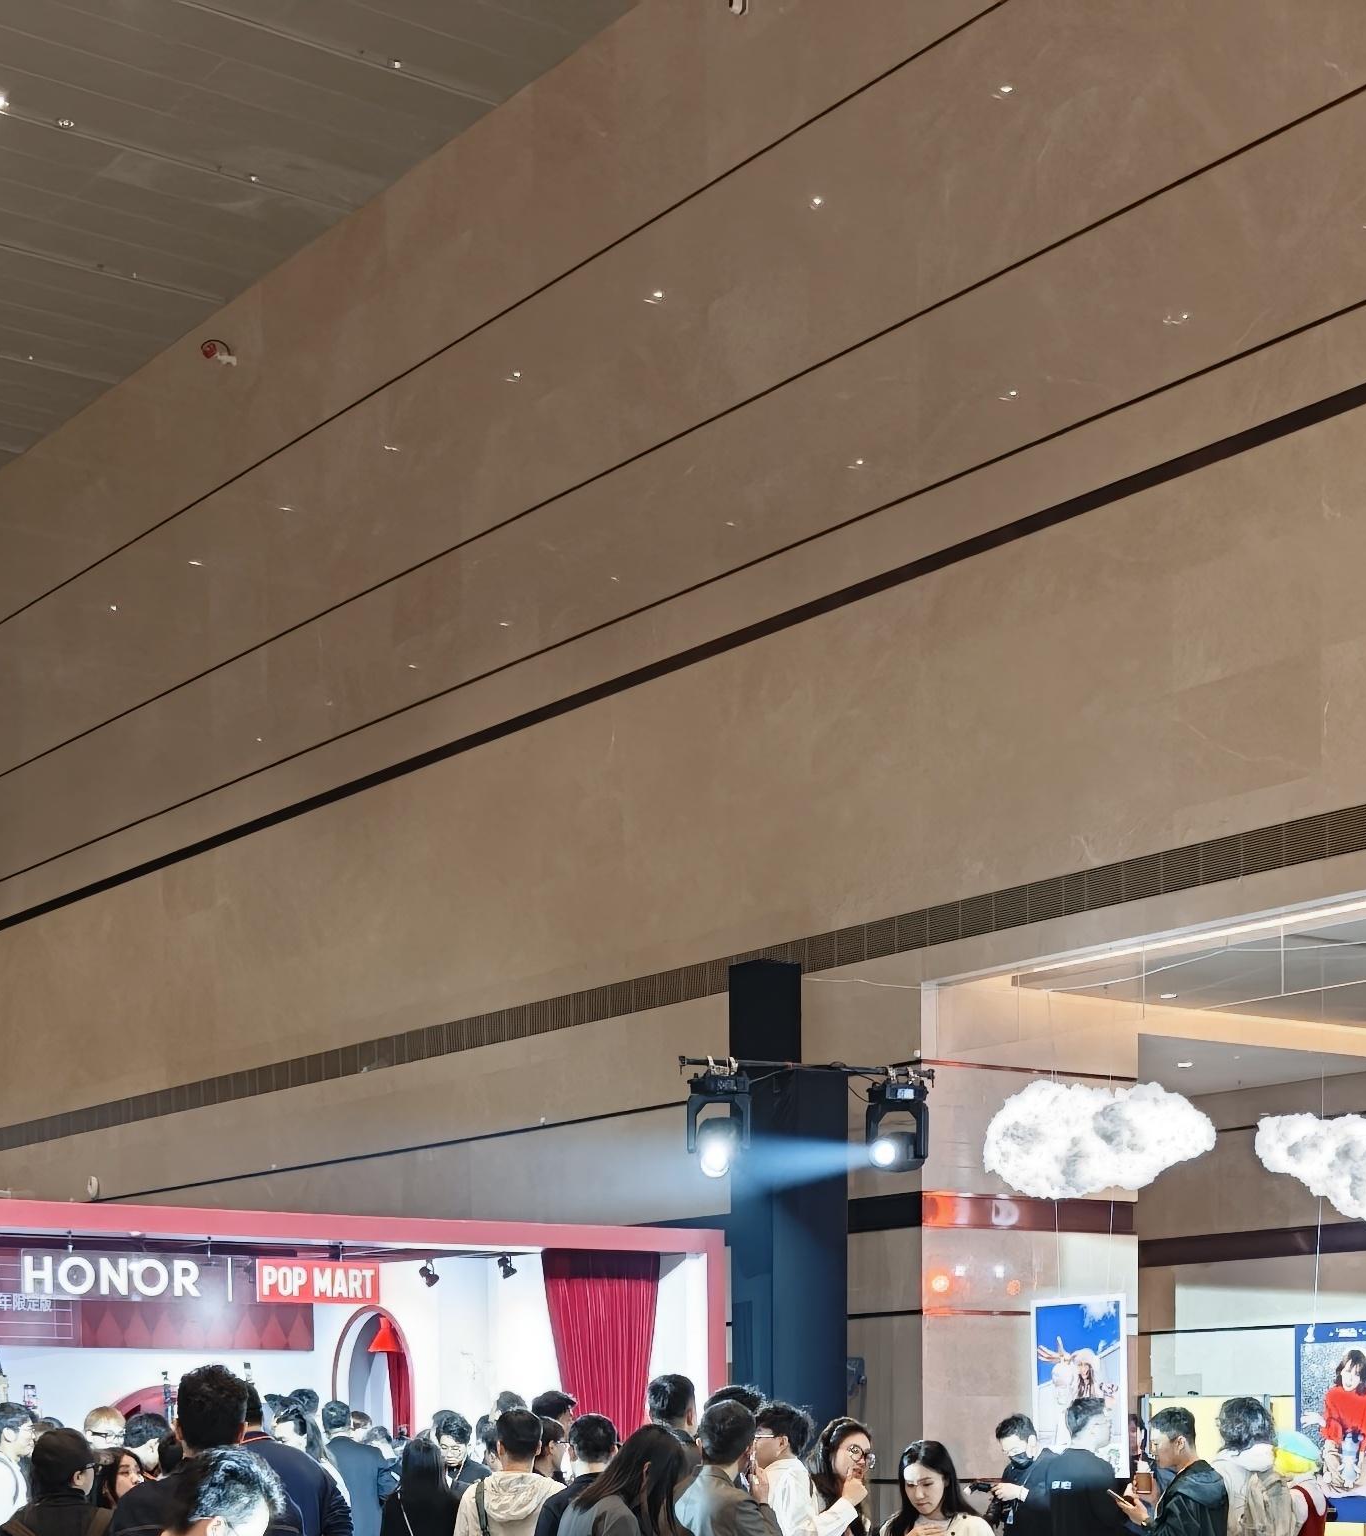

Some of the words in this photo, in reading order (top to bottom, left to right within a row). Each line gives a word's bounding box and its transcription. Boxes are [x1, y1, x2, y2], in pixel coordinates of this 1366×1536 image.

[23, 1255, 202, 1298] HONOR
[262, 1265, 308, 1297] POP
[313, 1267, 375, 1299] MART
